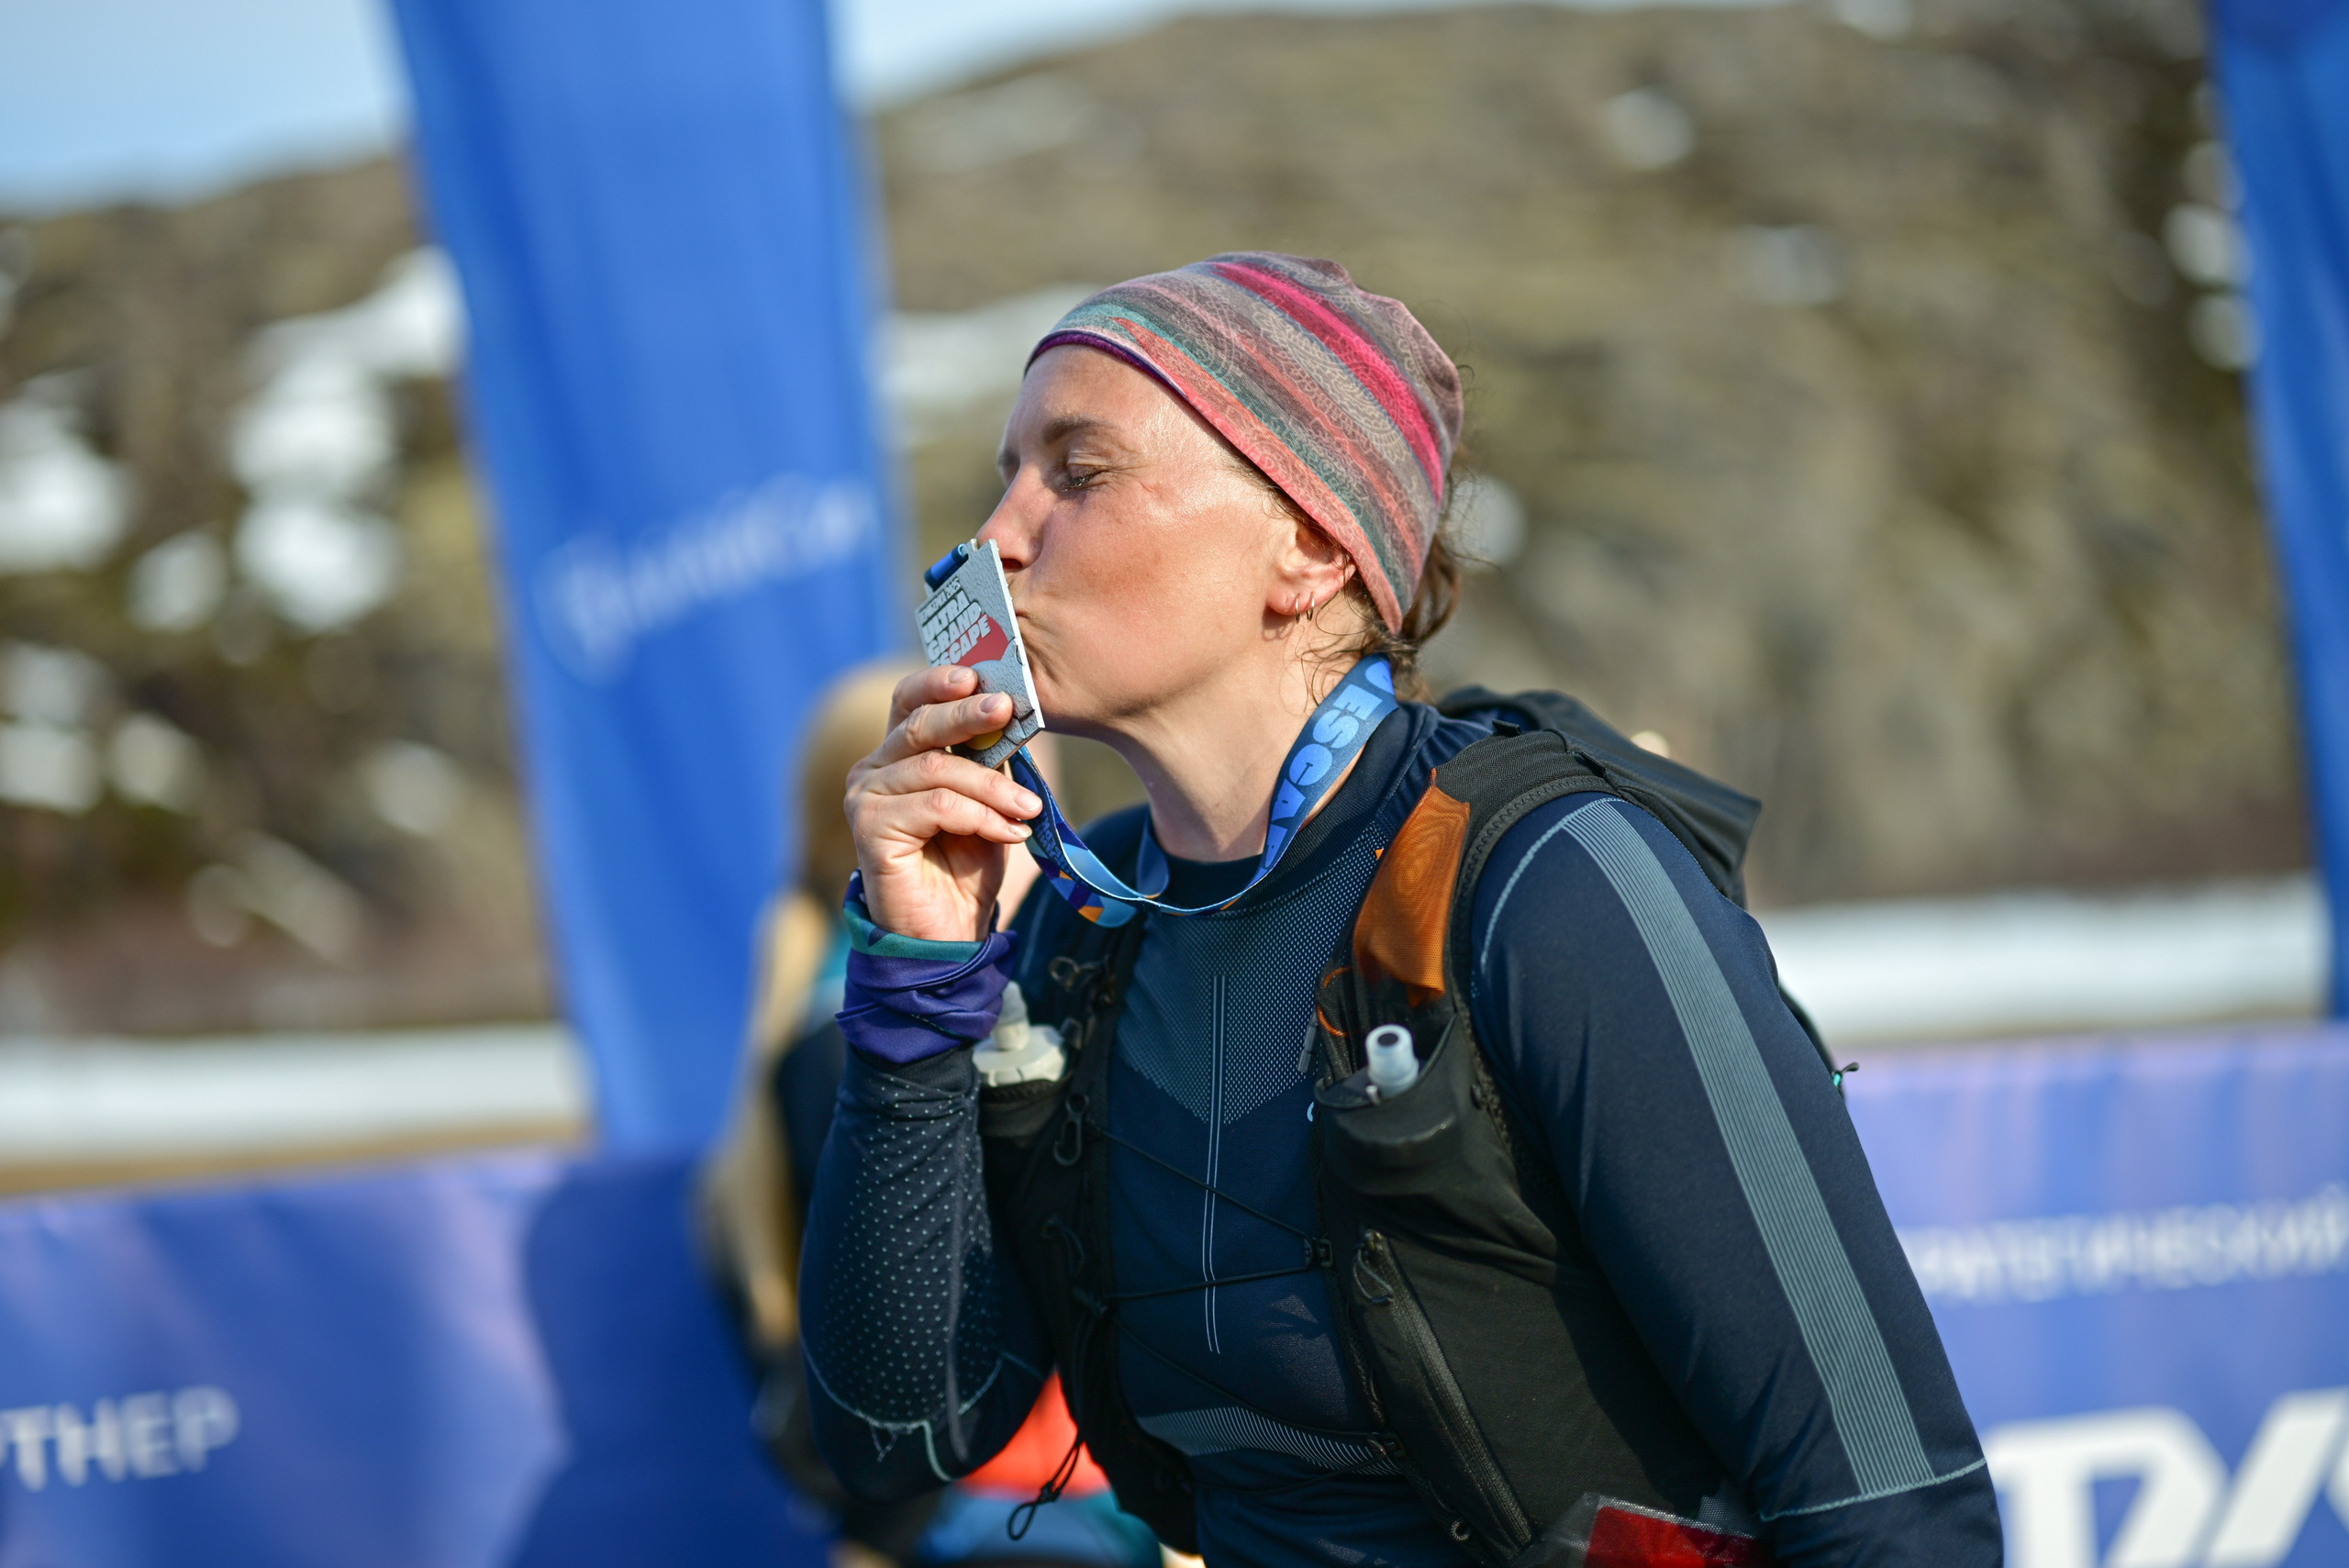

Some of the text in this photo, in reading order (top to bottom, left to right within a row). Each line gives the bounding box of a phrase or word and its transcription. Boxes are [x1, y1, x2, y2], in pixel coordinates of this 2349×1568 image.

[921, 589, 971, 644] ULTRA
[927, 601, 983, 662] GRAND
[930, 614, 991, 668] SCAPE
[0, 1385, 239, 1493] ТНЕР
